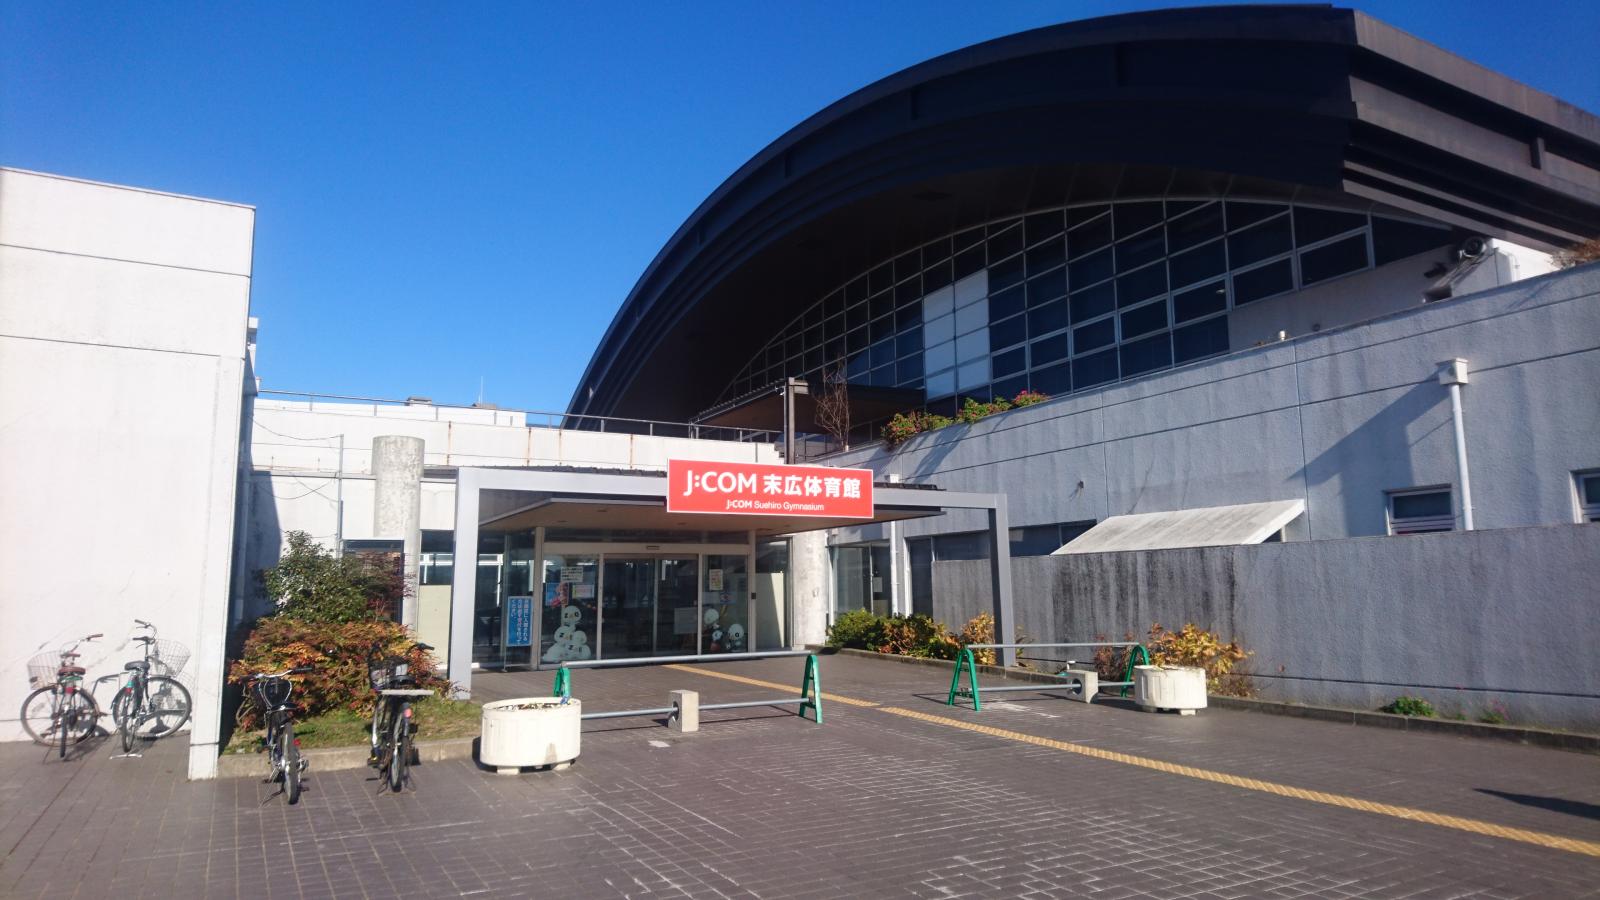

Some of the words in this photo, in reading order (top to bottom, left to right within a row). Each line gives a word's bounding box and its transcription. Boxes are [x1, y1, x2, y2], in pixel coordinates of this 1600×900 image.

[683, 469, 757, 496] J:COM
[763, 474, 861, 498] 末広体育館
[726, 499, 753, 510] J:COM
[754, 501, 781, 510] Suehiro
[783, 501, 825, 511] Gymnasium
